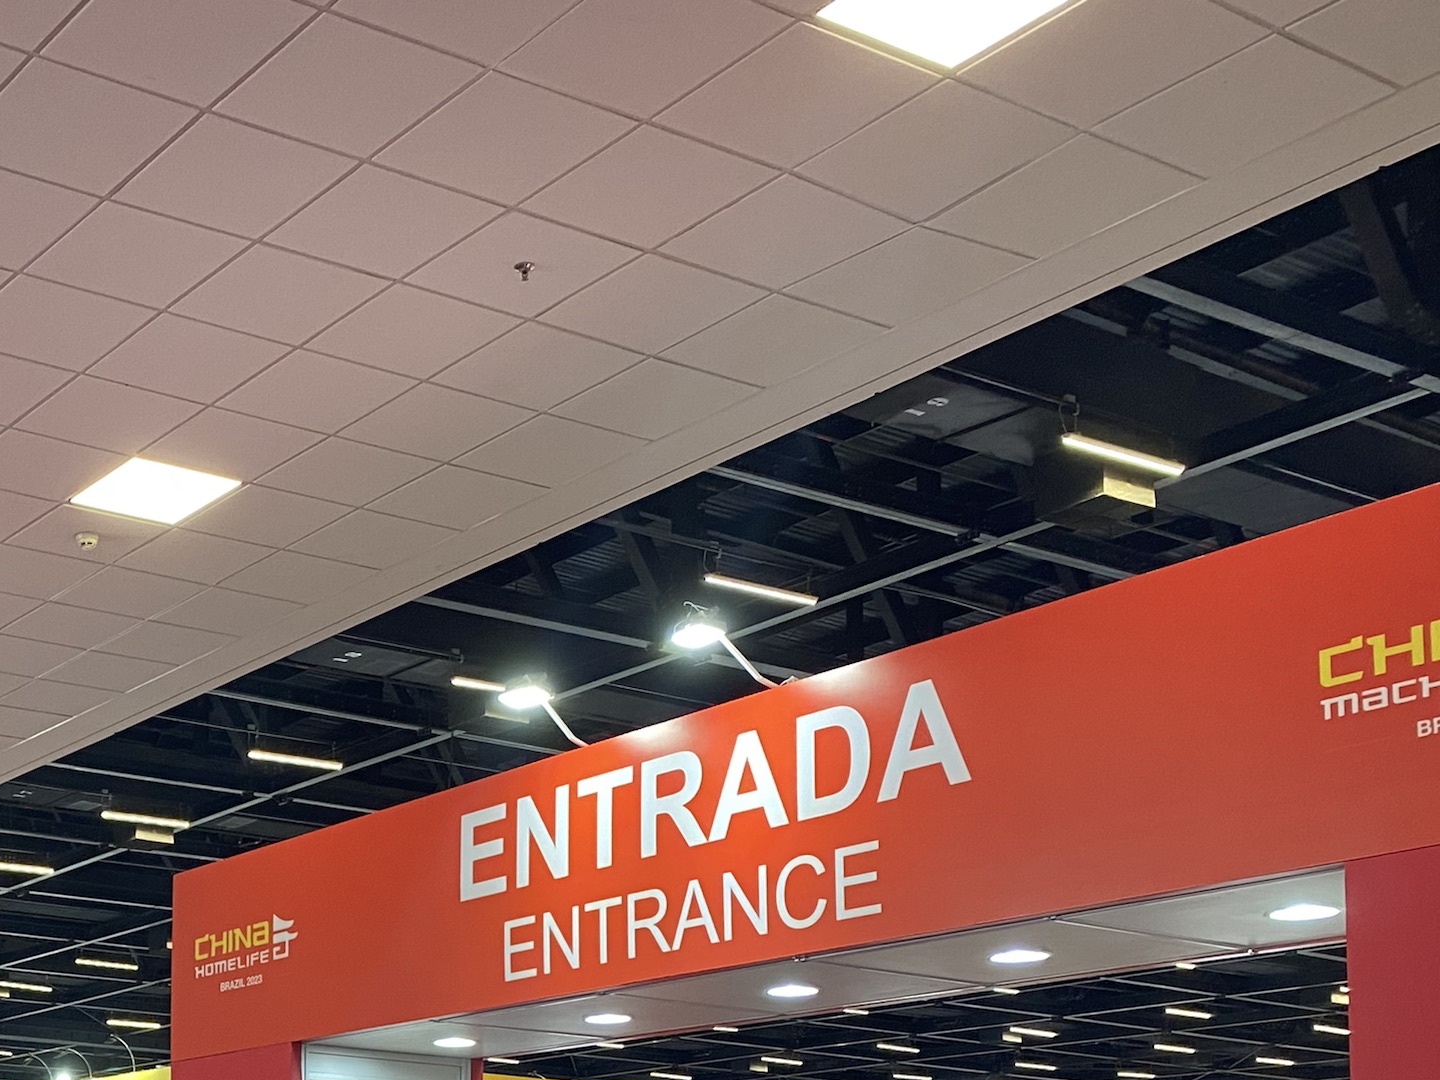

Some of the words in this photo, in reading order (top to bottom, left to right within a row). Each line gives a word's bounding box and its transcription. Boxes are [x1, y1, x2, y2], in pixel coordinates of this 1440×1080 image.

[459, 677, 972, 903] ENTRADA
[220, 978, 246, 992] BRAZIL
[246, 974, 263, 987] 2023
[503, 840, 883, 983] ENTRANCE
